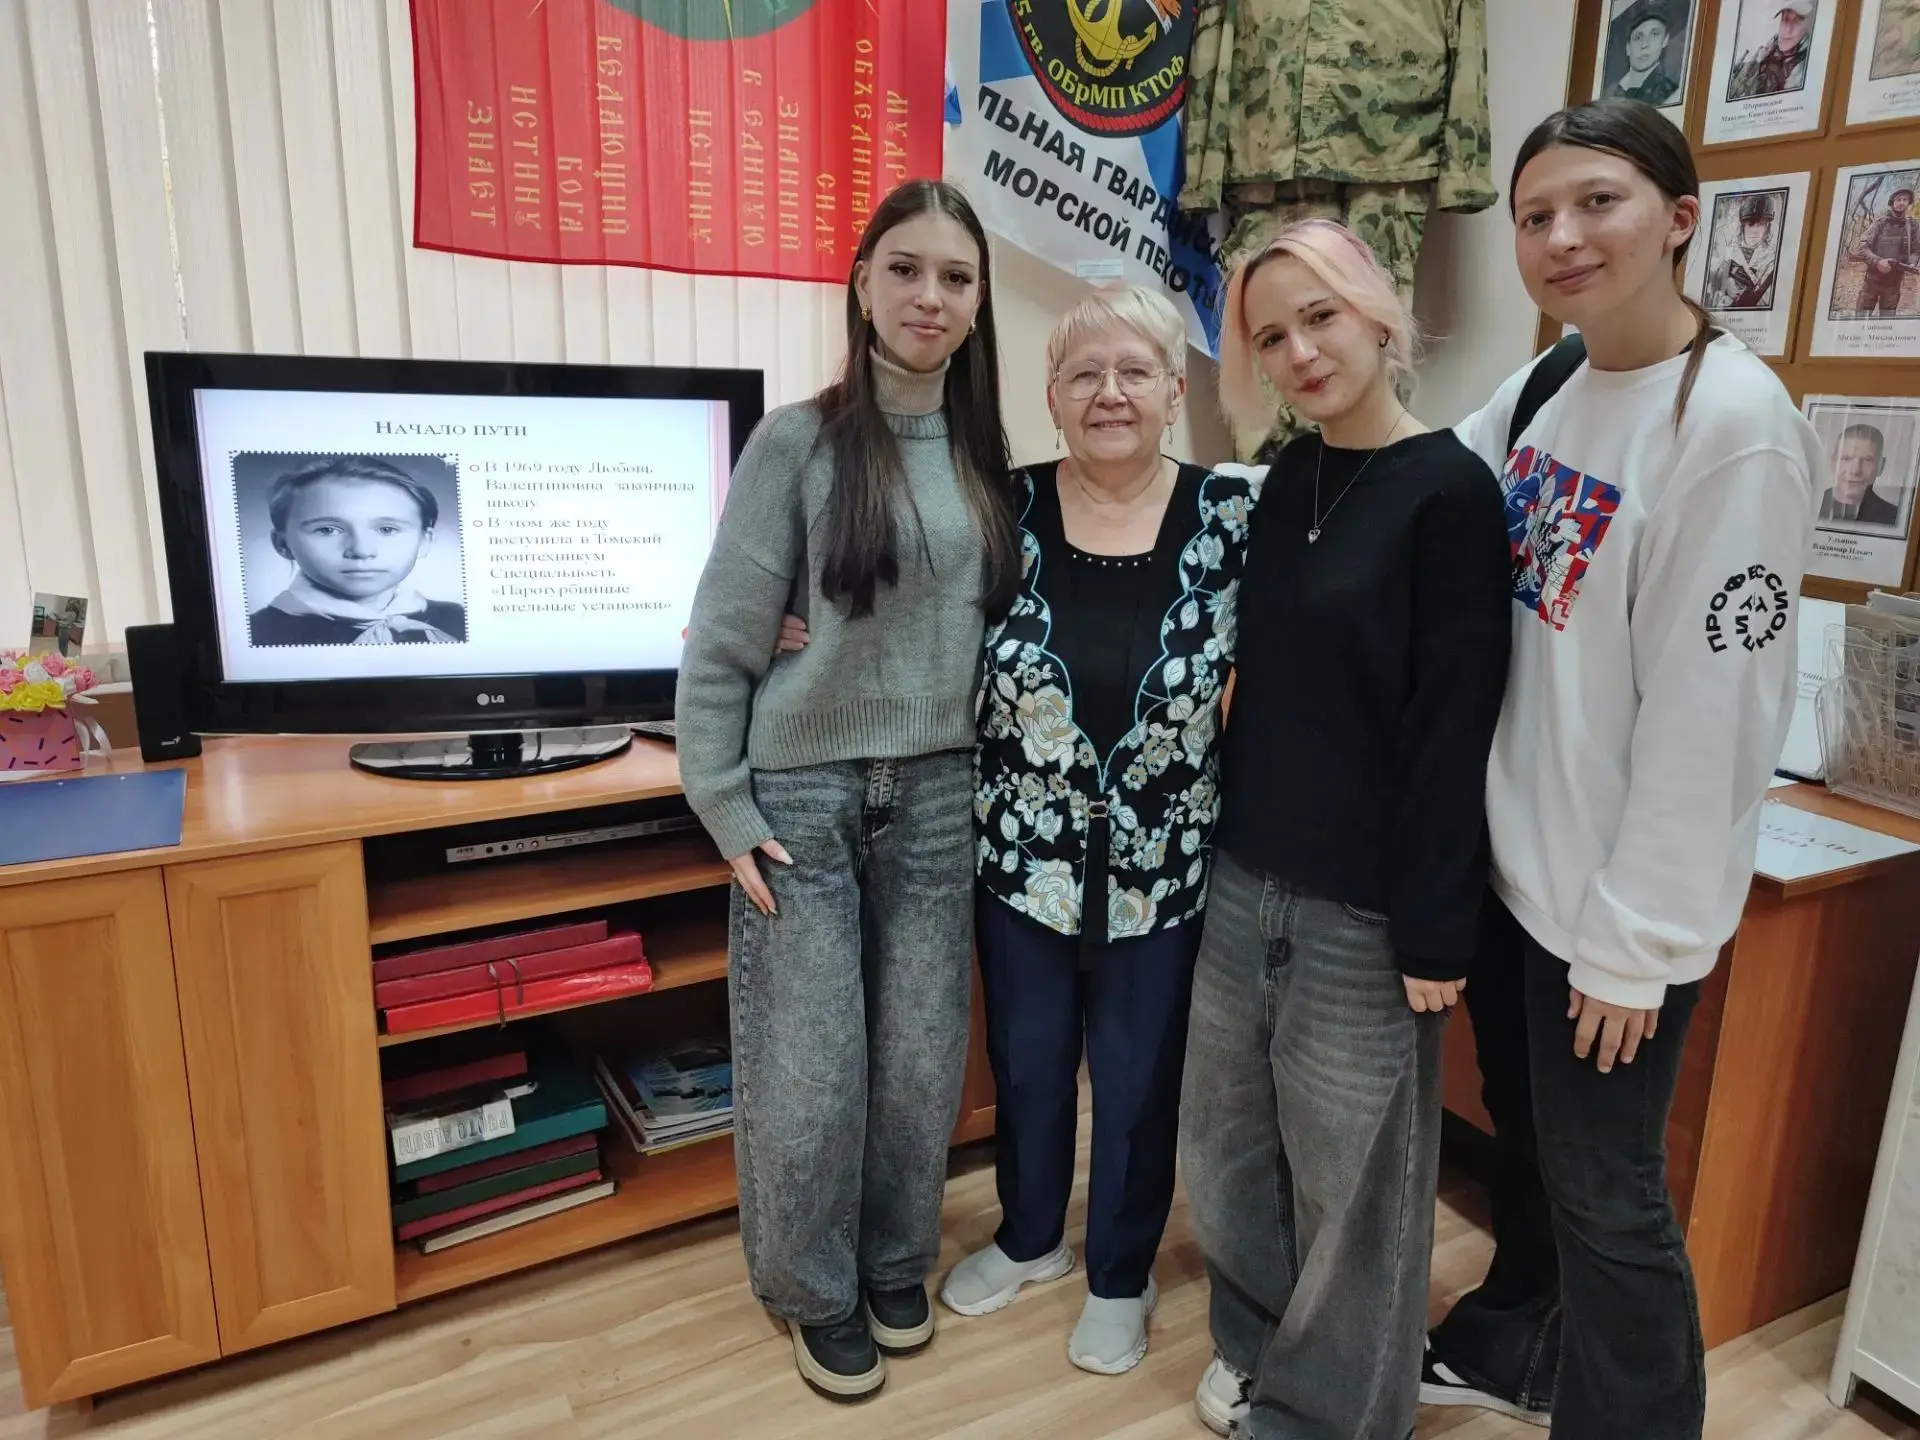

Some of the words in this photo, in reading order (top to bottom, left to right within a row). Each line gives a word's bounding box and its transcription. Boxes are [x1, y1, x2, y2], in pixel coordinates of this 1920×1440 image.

[1024, 22, 1044, 61] гв.
[1047, 58, 1126, 109] ОБрМП
[1129, 55, 1185, 106] КТОФ
[984, 150, 1131, 252] МОРСКОЙ
[485, 461, 497, 473] В
[505, 462, 542, 473] 1969
[548, 464, 582, 475] году
[588, 462, 654, 474] Любовь
[486, 479, 604, 491] Валентиновна
[614, 482, 695, 491] закончила
[487, 499, 537, 511] школу
[488, 517, 500, 528] В
[505, 519, 542, 528] этом
[550, 519, 571, 528] же
[576, 519, 609, 531] году
[489, 536, 573, 548] поступила
[581, 536, 590, 544] в
[591, 533, 662, 545] Томский
[490, 553, 606, 564] политехникум
[489, 567, 617, 580] Специальность
[492, 603, 576, 613] котельные
[490, 694, 505, 704] LG
[457, 1110, 508, 1140] PHOTO
[399, 1124, 452, 1155] ALBUM
